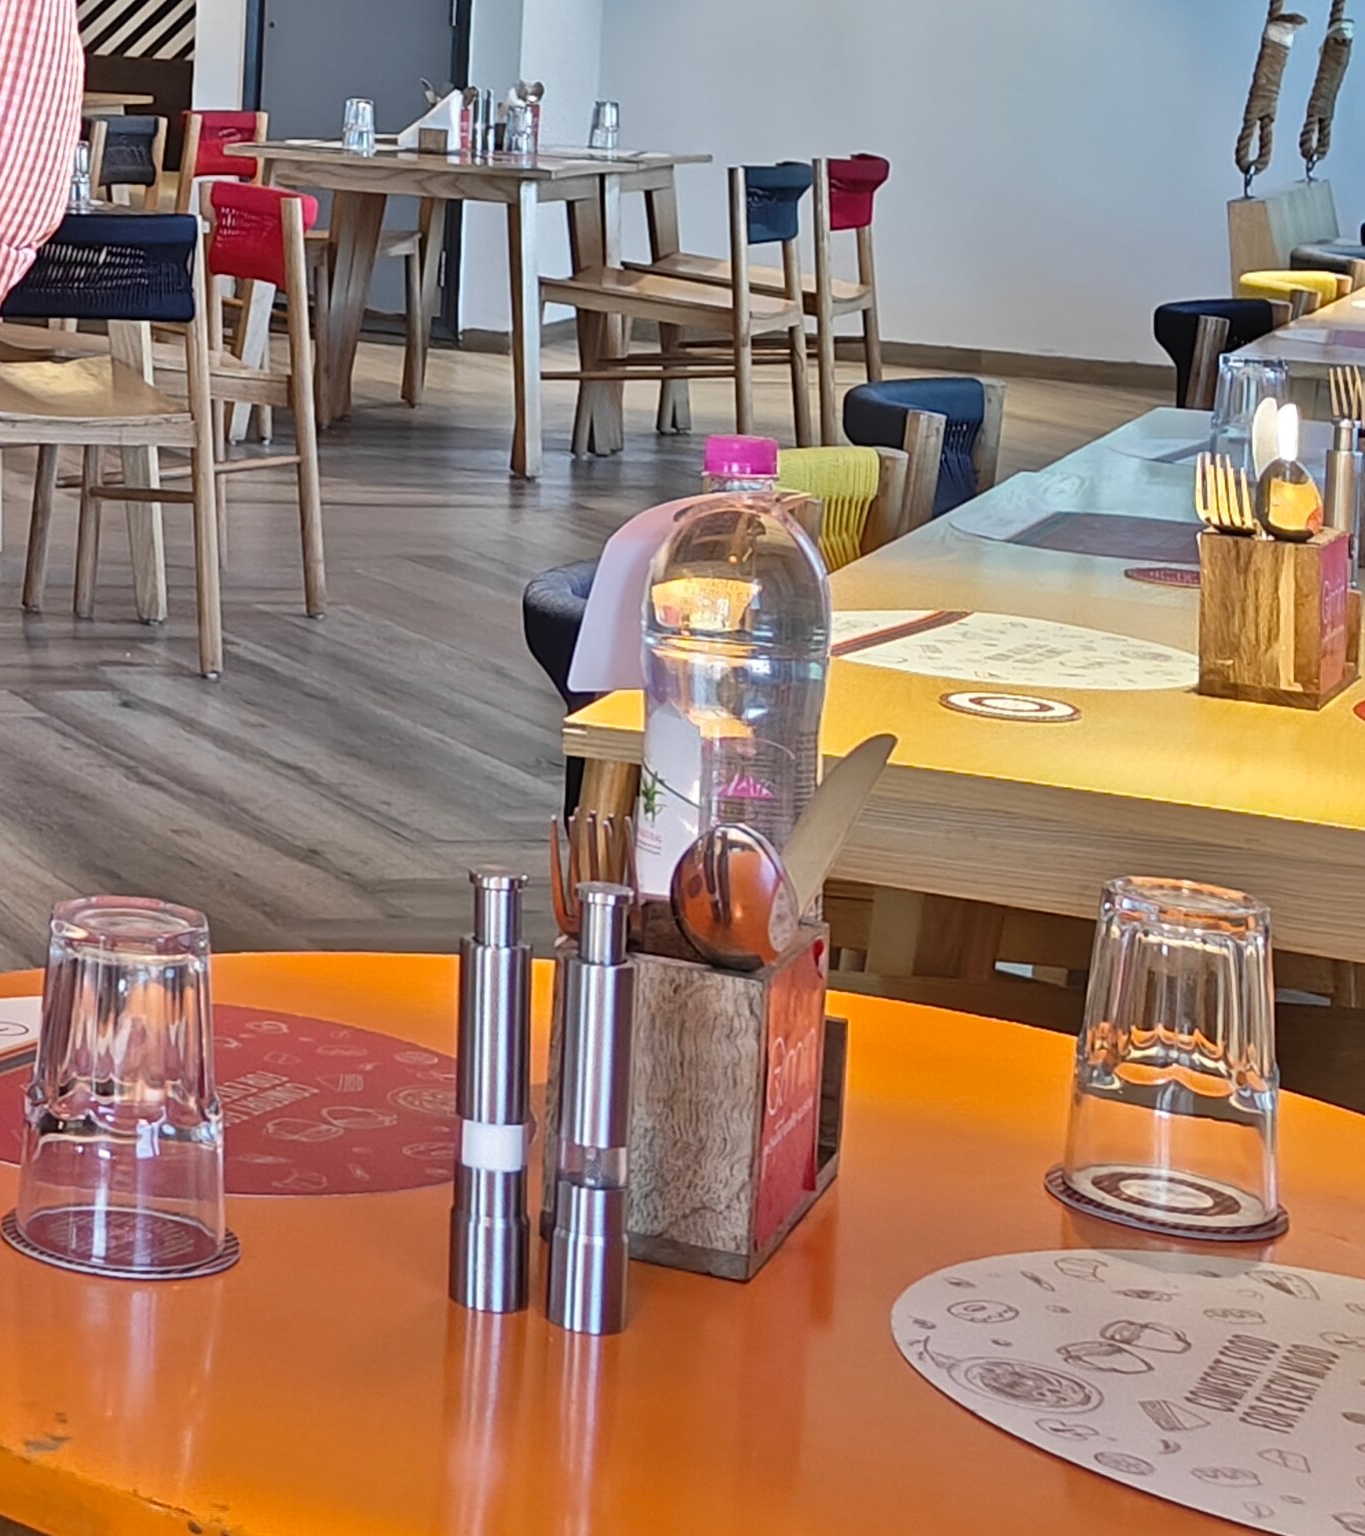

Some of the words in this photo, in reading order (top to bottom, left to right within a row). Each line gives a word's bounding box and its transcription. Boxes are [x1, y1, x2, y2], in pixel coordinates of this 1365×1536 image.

[1218, 1333, 1281, 1366] FOOD
[1277, 1343, 1341, 1380] MOOD
[1184, 1357, 1263, 1413] COMFORT
[1254, 1370, 1322, 1413] EVERY
[1238, 1404, 1300, 1435] FOR
